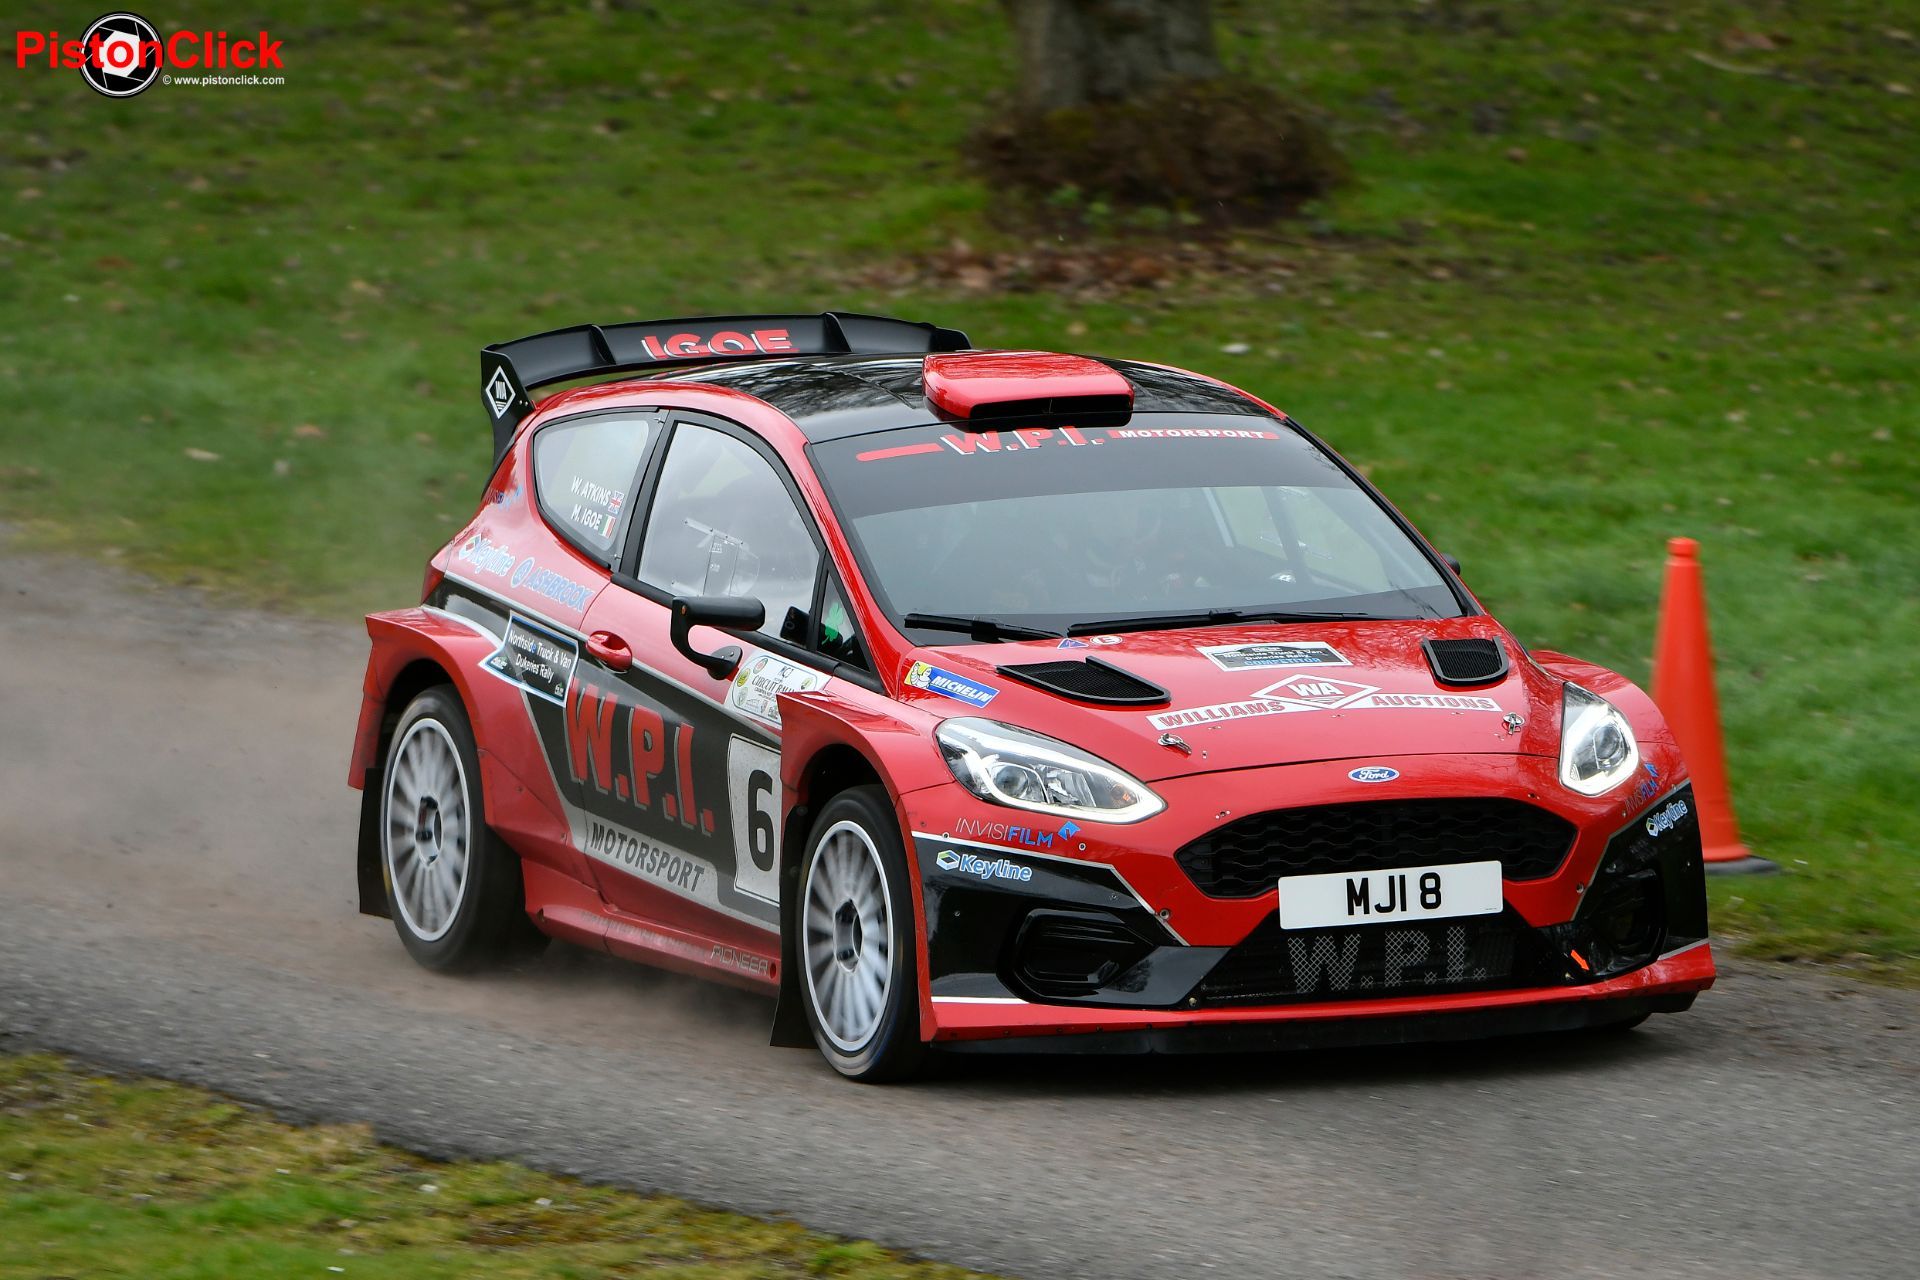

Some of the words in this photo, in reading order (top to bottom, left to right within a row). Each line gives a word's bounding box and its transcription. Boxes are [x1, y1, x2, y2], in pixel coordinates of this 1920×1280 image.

[642, 329, 798, 360] IGOE
[1119, 429, 1265, 439] MOTORSPORT
[580, 507, 602, 530] IGOE
[508, 629, 537, 653] Northside
[536, 641, 554, 661] Truck
[553, 650, 560, 664] &
[560, 651, 572, 669] Van
[1244, 658, 1321, 667] COMPETITOR
[515, 653, 540, 675] Dukeries
[539, 663, 554, 684] Rally
[931, 675, 993, 703] MICHELIN
[1289, 681, 1345, 698] WA
[1158, 700, 1286, 728] WILLIAMS
[1370, 694, 1497, 711] AUCTIONS
[563, 677, 715, 837] W.P.I.
[1358, 768, 1391, 782] Ford
[748, 769, 775, 872] 6
[1653, 799, 1688, 831] Keyline
[955, 817, 1053, 848] INVISIFILM
[590, 822, 705, 893] MOTORSPORT
[959, 853, 1032, 881] Keyline
[710, 945, 769, 976] PIONEER
[1287, 926, 1487, 994] W.P.I.
